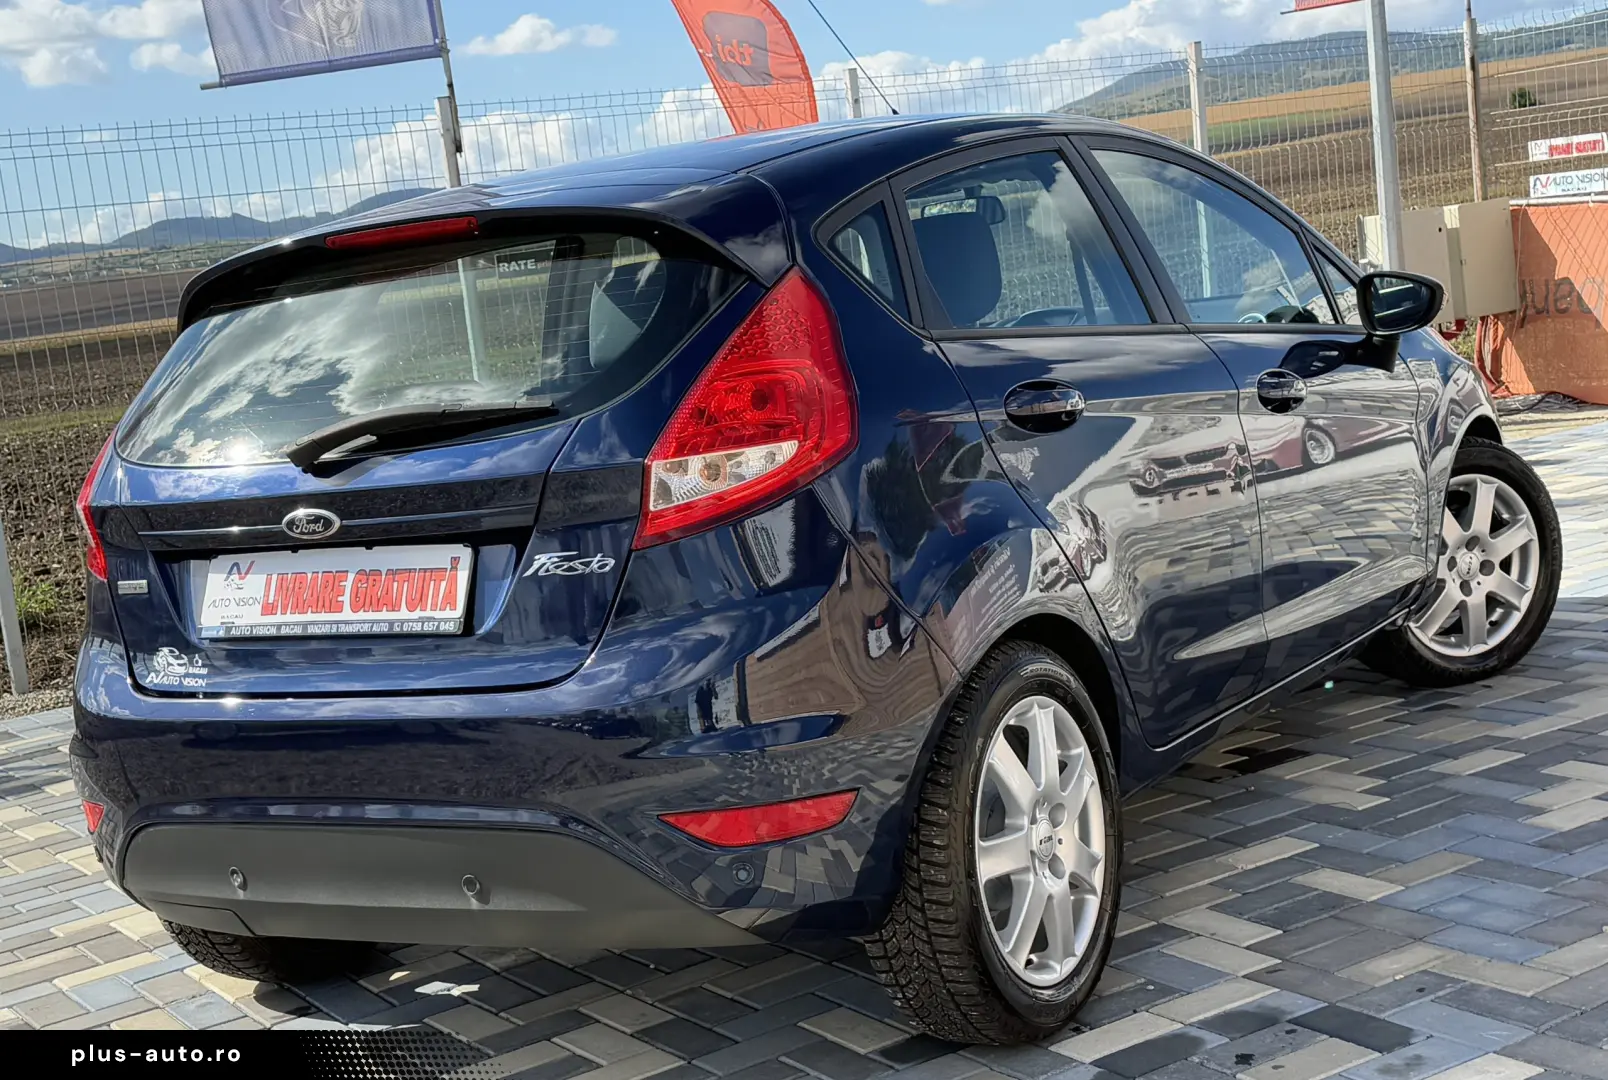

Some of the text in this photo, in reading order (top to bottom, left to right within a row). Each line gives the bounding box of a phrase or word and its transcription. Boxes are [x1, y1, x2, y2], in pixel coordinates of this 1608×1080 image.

[499, 259, 537, 273] RATE
[522, 551, 616, 578] Fiesta
[260, 556, 461, 617] LIVRARE GRATUITĂ
[207, 596, 261, 609] AUTO VISION
[230, 626, 251, 635] AUTO
[252, 625, 277, 635] VISION
[1029, 667, 1064, 678] ROTATION
[181, 677, 207, 687] VISION
